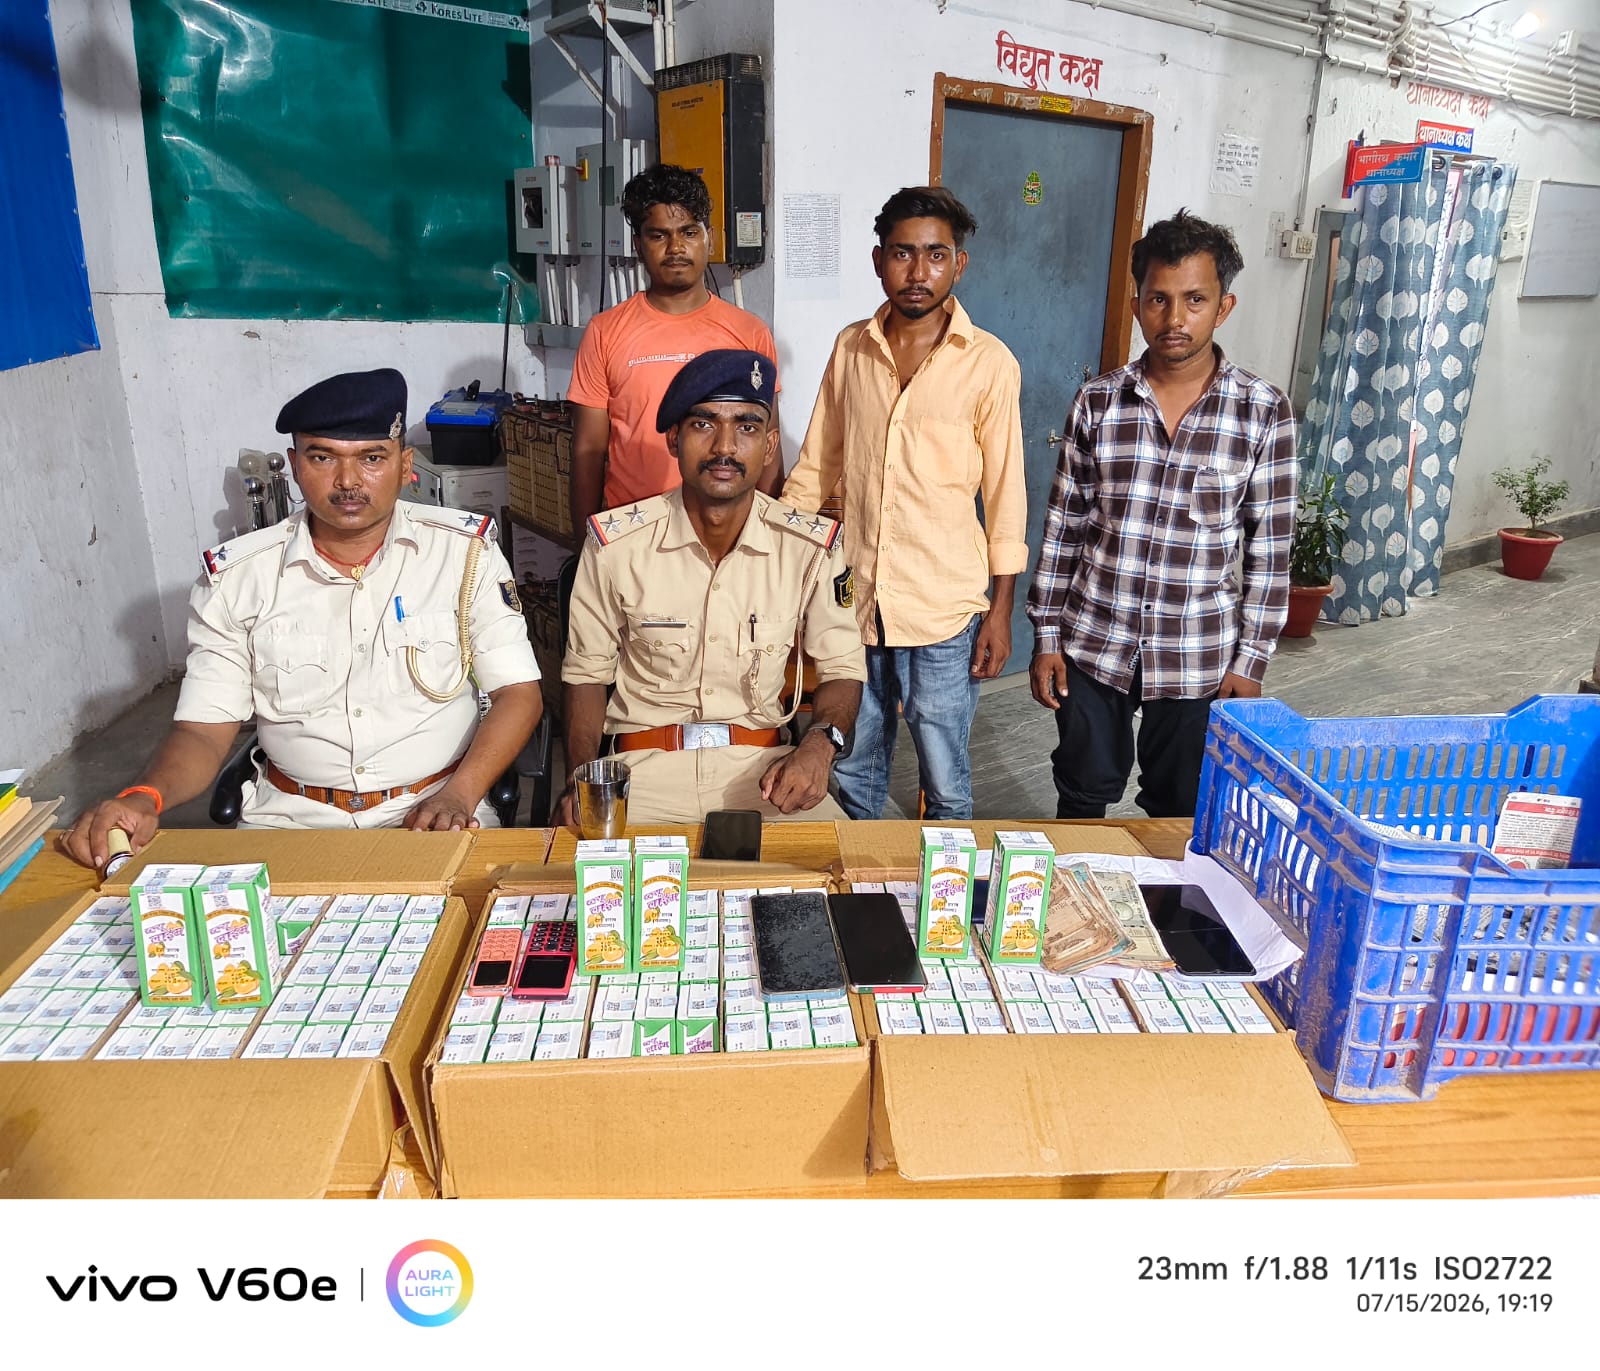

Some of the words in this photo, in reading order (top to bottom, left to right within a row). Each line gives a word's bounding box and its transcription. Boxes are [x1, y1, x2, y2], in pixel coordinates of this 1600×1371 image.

[995, 30, 1055, 90] विद्युत
[1059, 53, 1104, 97] कक्ष
[1407, 82, 1464, 117] थानाध्यक्ष
[1468, 94, 1491, 124] कक्ष
